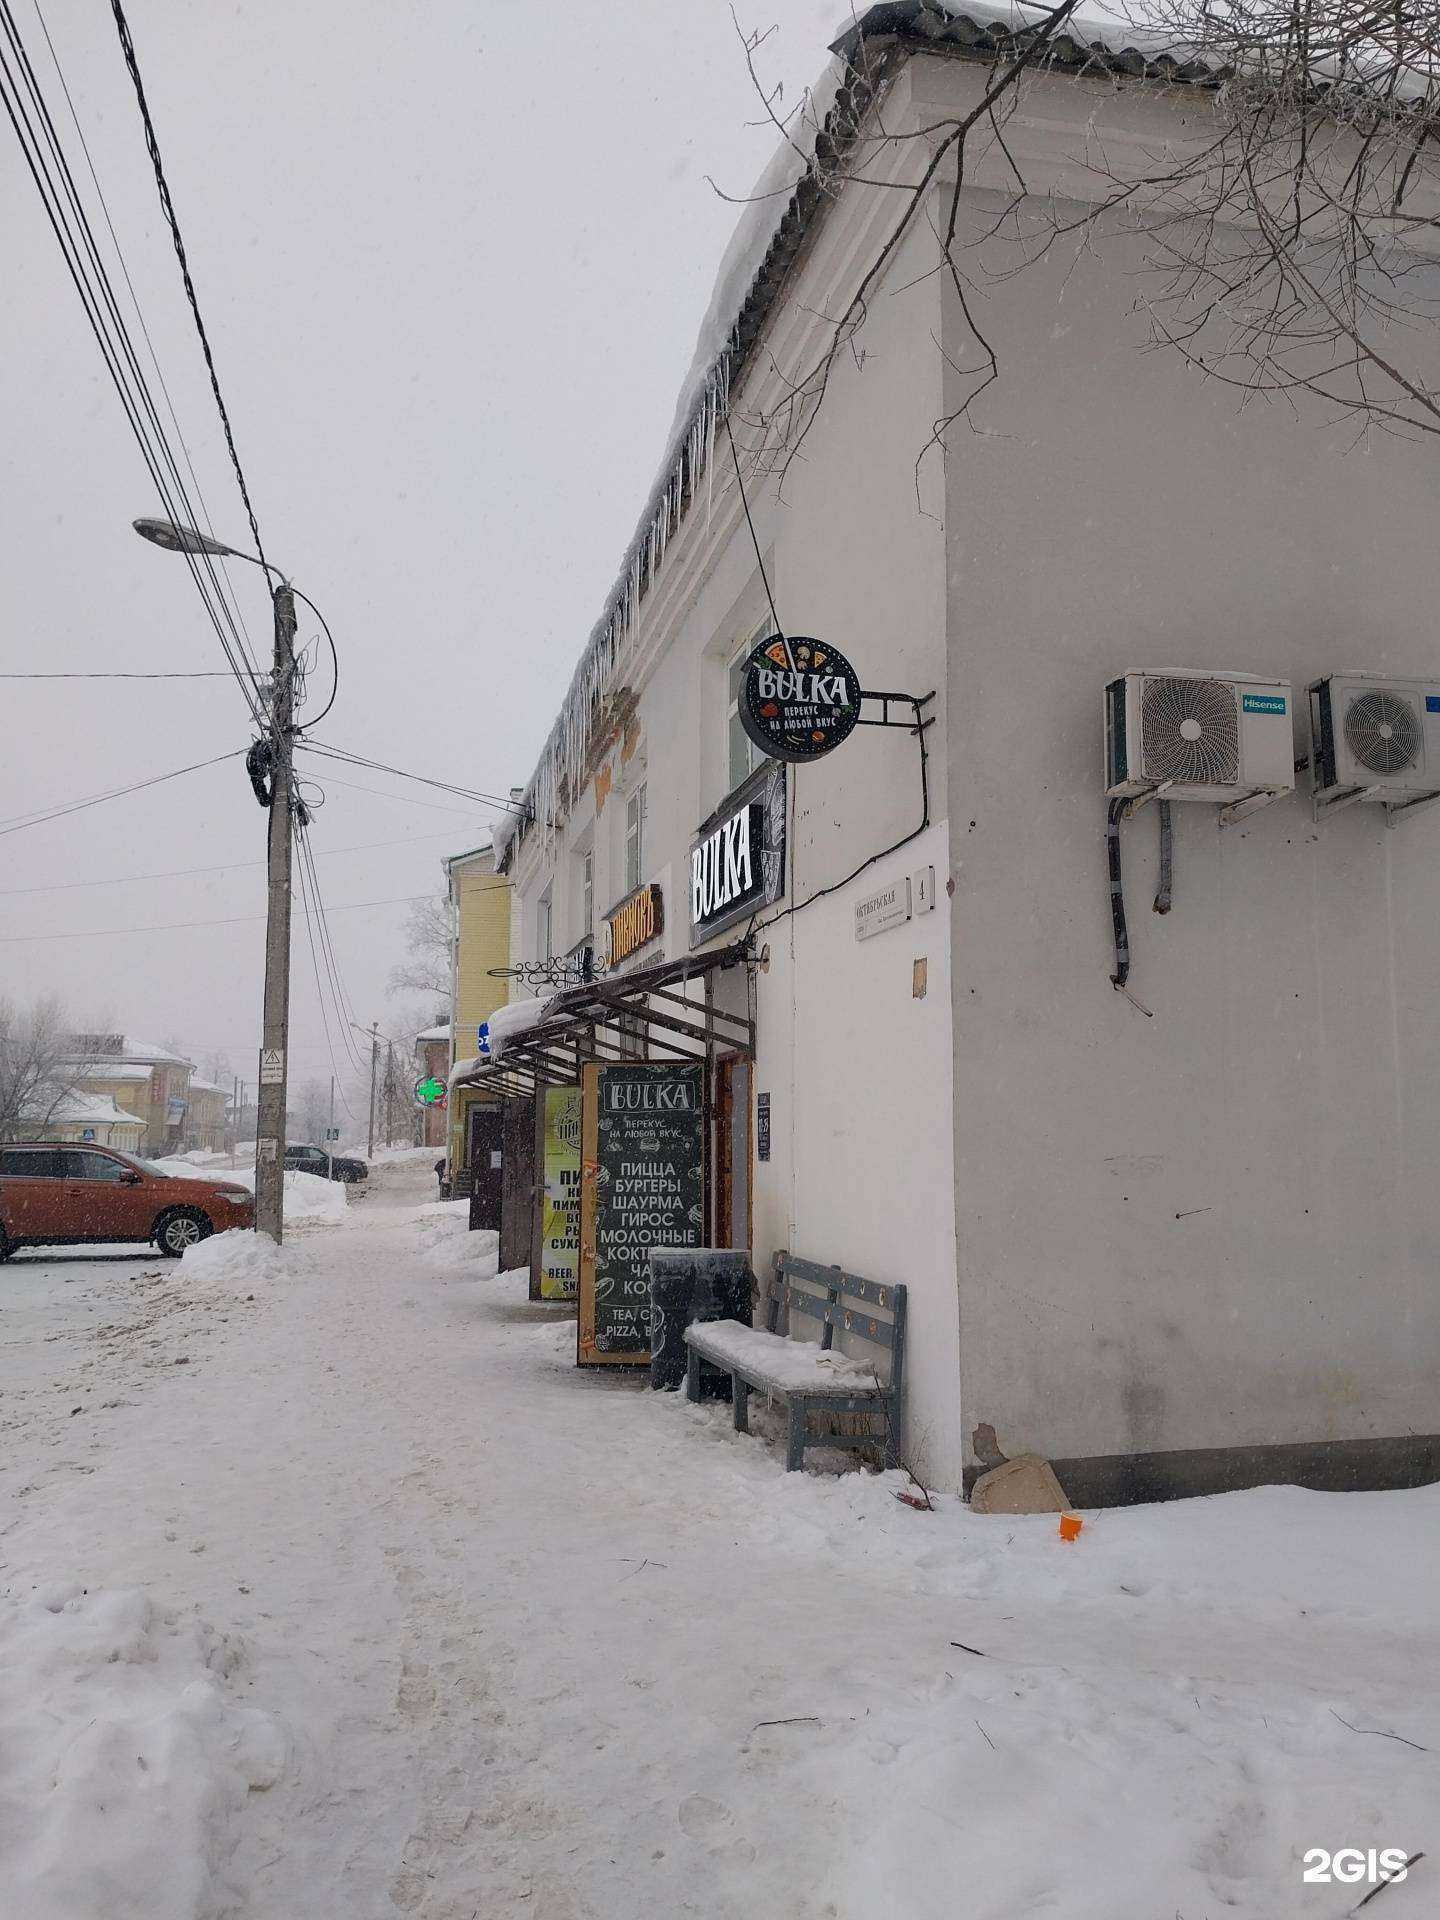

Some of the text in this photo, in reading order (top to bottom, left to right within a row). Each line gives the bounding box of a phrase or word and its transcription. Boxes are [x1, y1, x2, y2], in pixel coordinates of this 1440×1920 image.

[758, 668, 849, 705] BULKA
[784, 705, 819, 717] ПЕРЕКУС
[1244, 699, 1284, 710] Hisense
[770, 717, 836, 730] НА ЛЮБОЙ ВКУС
[692, 804, 753, 924] BULKA
[611, 1084, 690, 1109] BULKA
[626, 1119, 667, 1129] ПЕРЕКУС
[610, 1129, 682, 1139] НА ЛЮБОЙ ВКУС
[621, 1162, 676, 1178] ПИЦЦА
[615, 1179, 681, 1193] БУРГЕРЫ
[612, 1195, 684, 1210] ШАУРМА
[621, 1212, 674, 1227] ГИРОС
[600, 1229, 695, 1244] МОЛОЧНЫЕ
[607, 1246, 650, 1260] КОКТ
[613, 1309, 637, 1322] TEA,
[606, 1325, 641, 1339] PIZZA,
